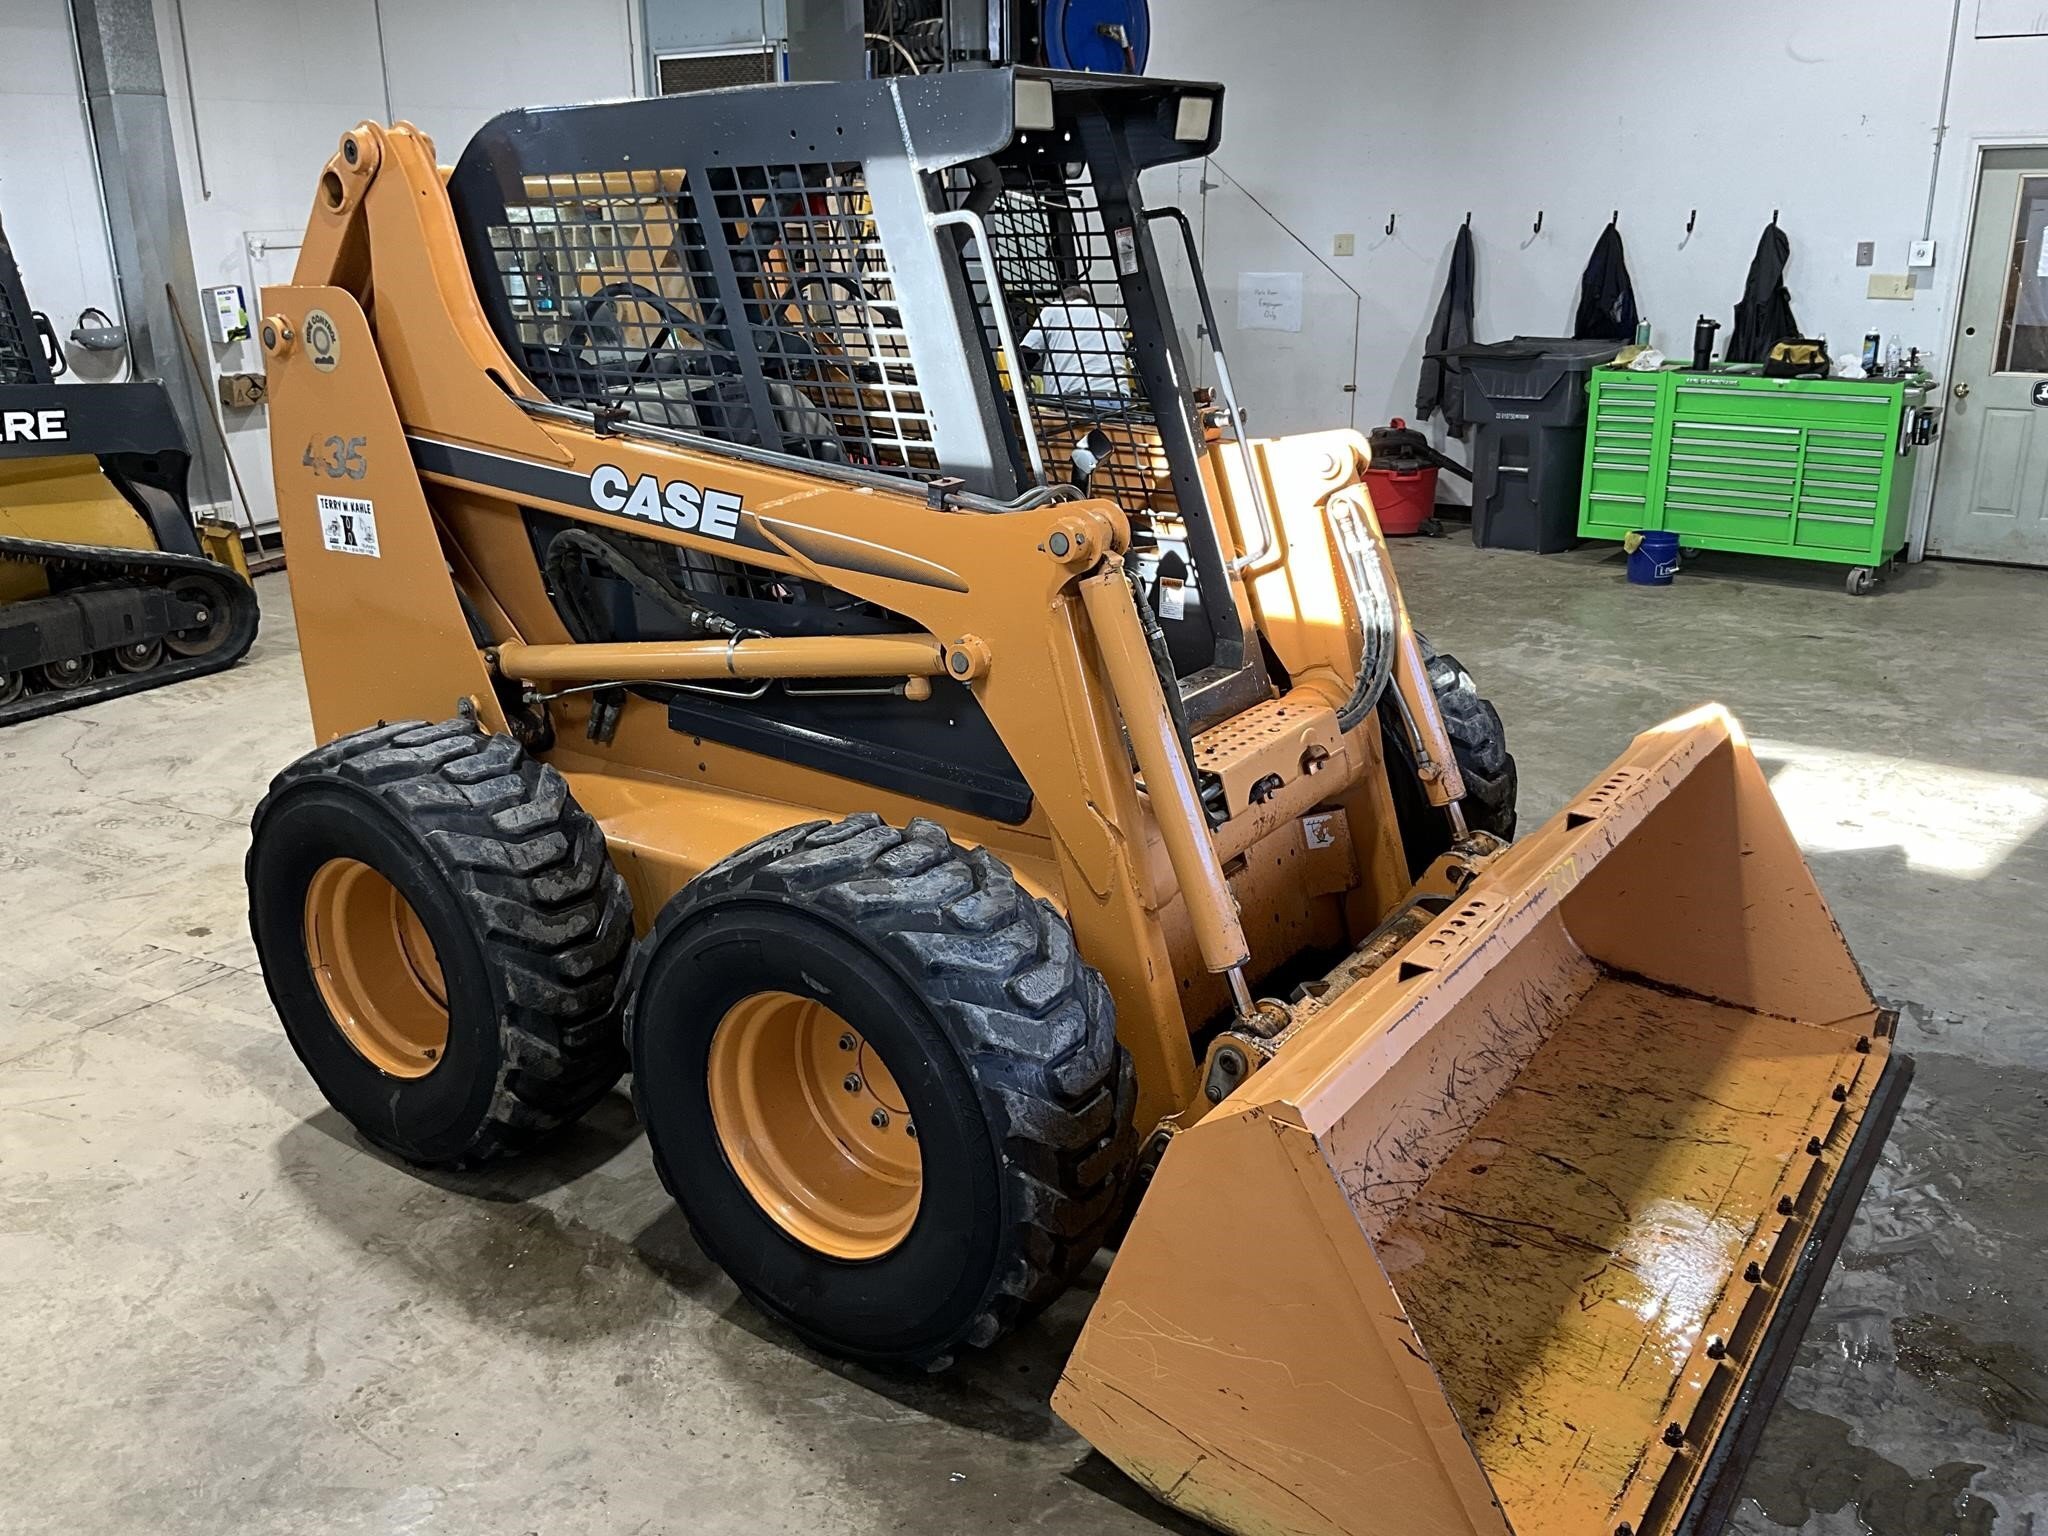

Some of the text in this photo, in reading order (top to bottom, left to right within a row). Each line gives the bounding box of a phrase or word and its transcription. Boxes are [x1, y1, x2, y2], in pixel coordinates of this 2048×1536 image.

[0, 410, 68, 442] RE
[302, 434, 367, 480] 435
[320, 498, 342, 511] TERRY
[350, 502, 371, 514] KAHLE
[590, 464, 742, 540] CASE
